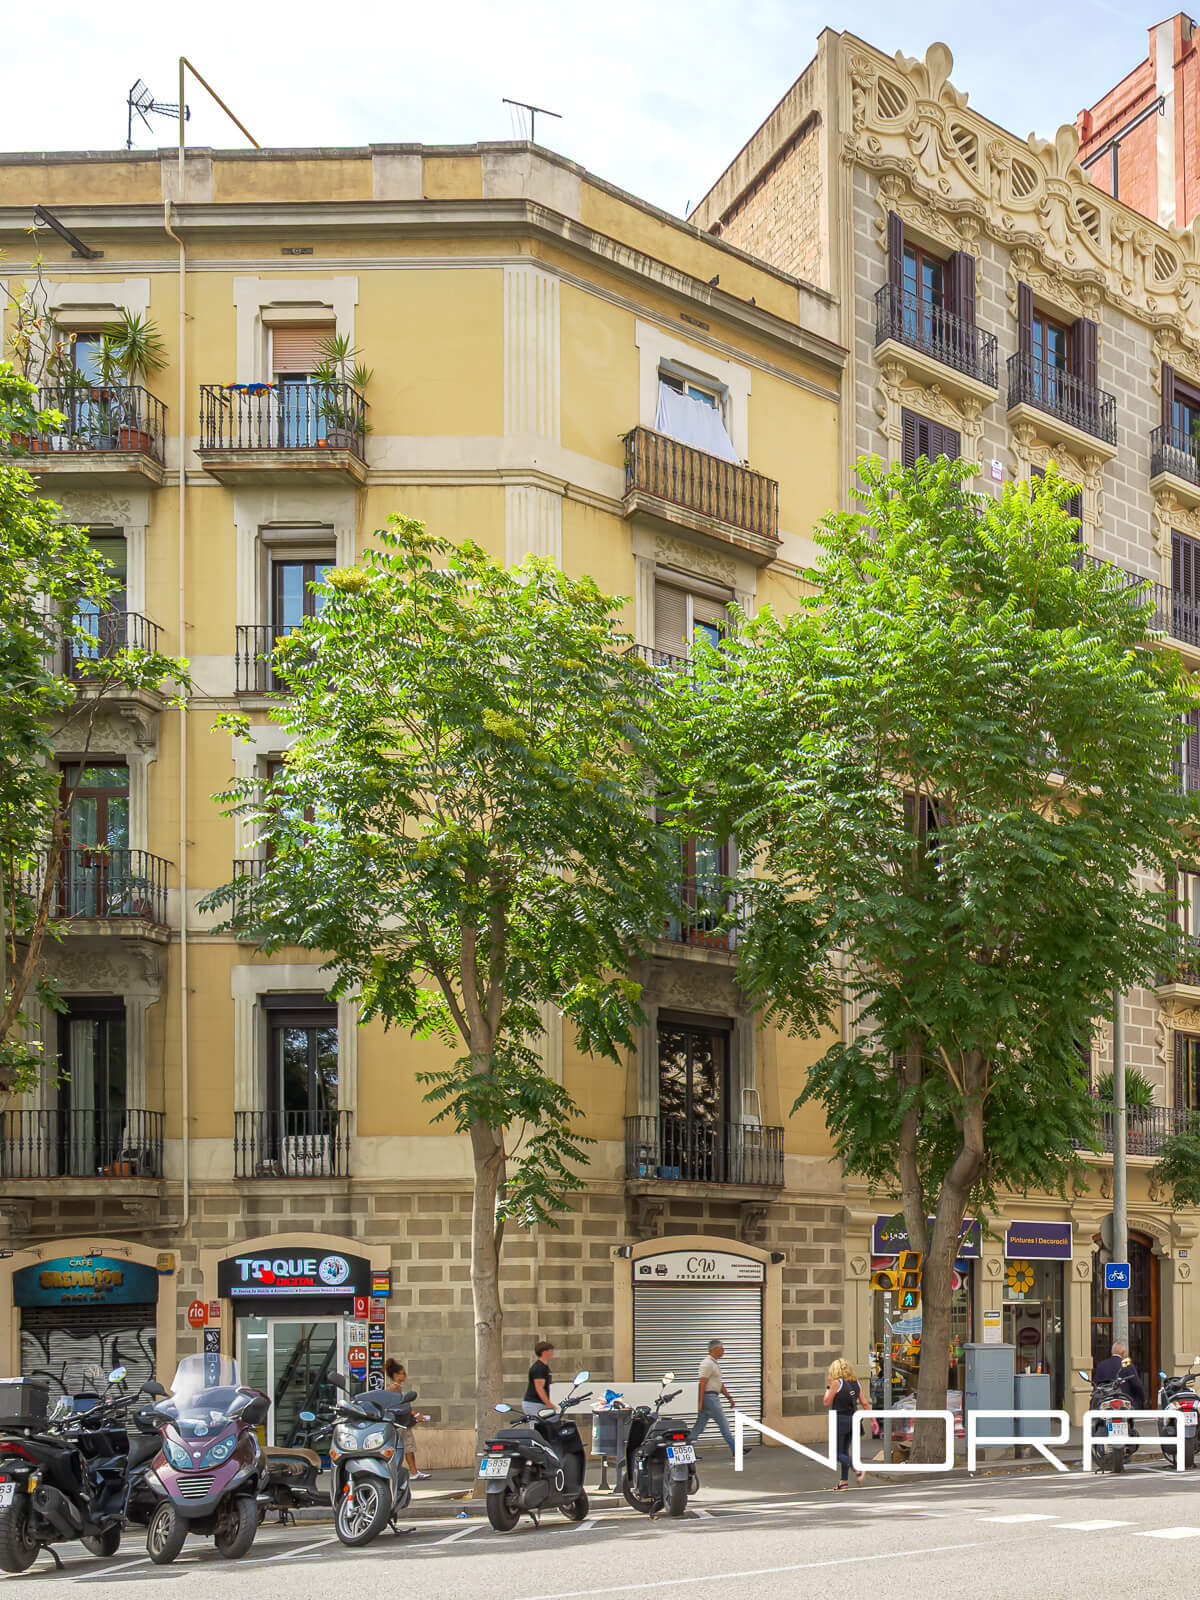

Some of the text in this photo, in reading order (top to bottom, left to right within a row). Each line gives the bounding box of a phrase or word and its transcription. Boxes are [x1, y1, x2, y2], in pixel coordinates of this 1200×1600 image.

[1010, 1236, 1034, 1244] Pintures
[687, 1256, 715, 1273] CW
[276, 1277, 317, 1286] DIGITAL
[190, 1303, 204, 1318] ria
[349, 1349, 366, 1360] ria
